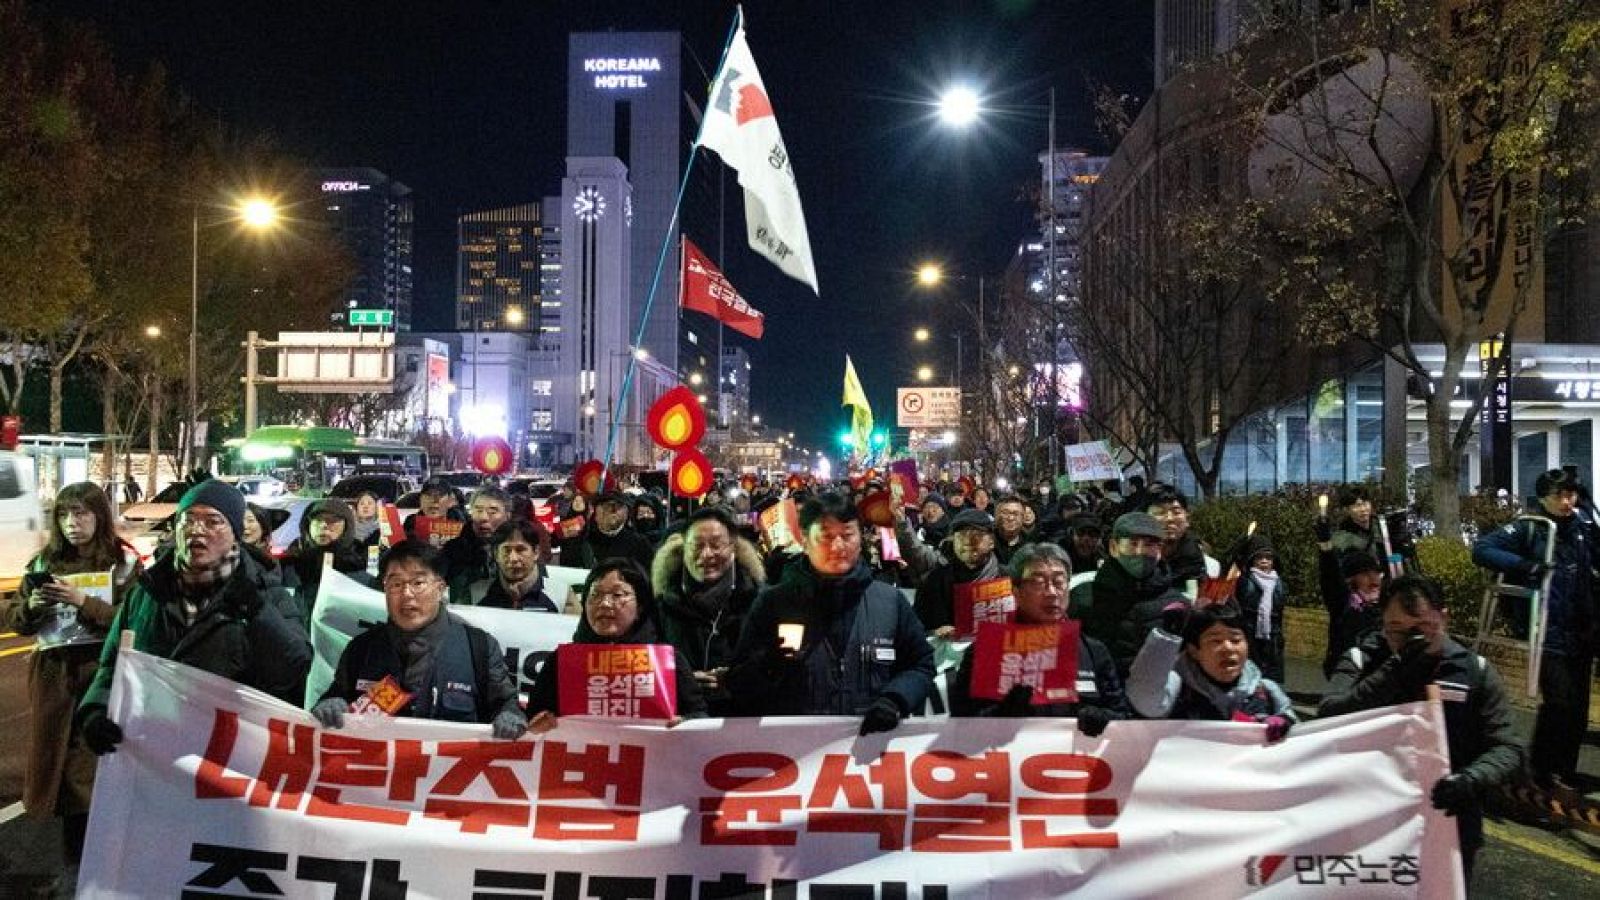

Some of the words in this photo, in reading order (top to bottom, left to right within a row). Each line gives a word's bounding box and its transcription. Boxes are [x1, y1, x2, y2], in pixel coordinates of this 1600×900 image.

[585, 57, 661, 72] KOREANA
[595, 74, 648, 89] HOTEL
[587, 649, 654, 674] 내란죄
[1000, 648, 1058, 679] 윤석열
[586, 673, 655, 698] 윤석열
[587, 699, 641, 718] 퇴진!
[195, 707, 645, 842] 내란주범
[700, 750, 1120, 853] 윤석열은
[1294, 854, 1421, 886] 민주노총
